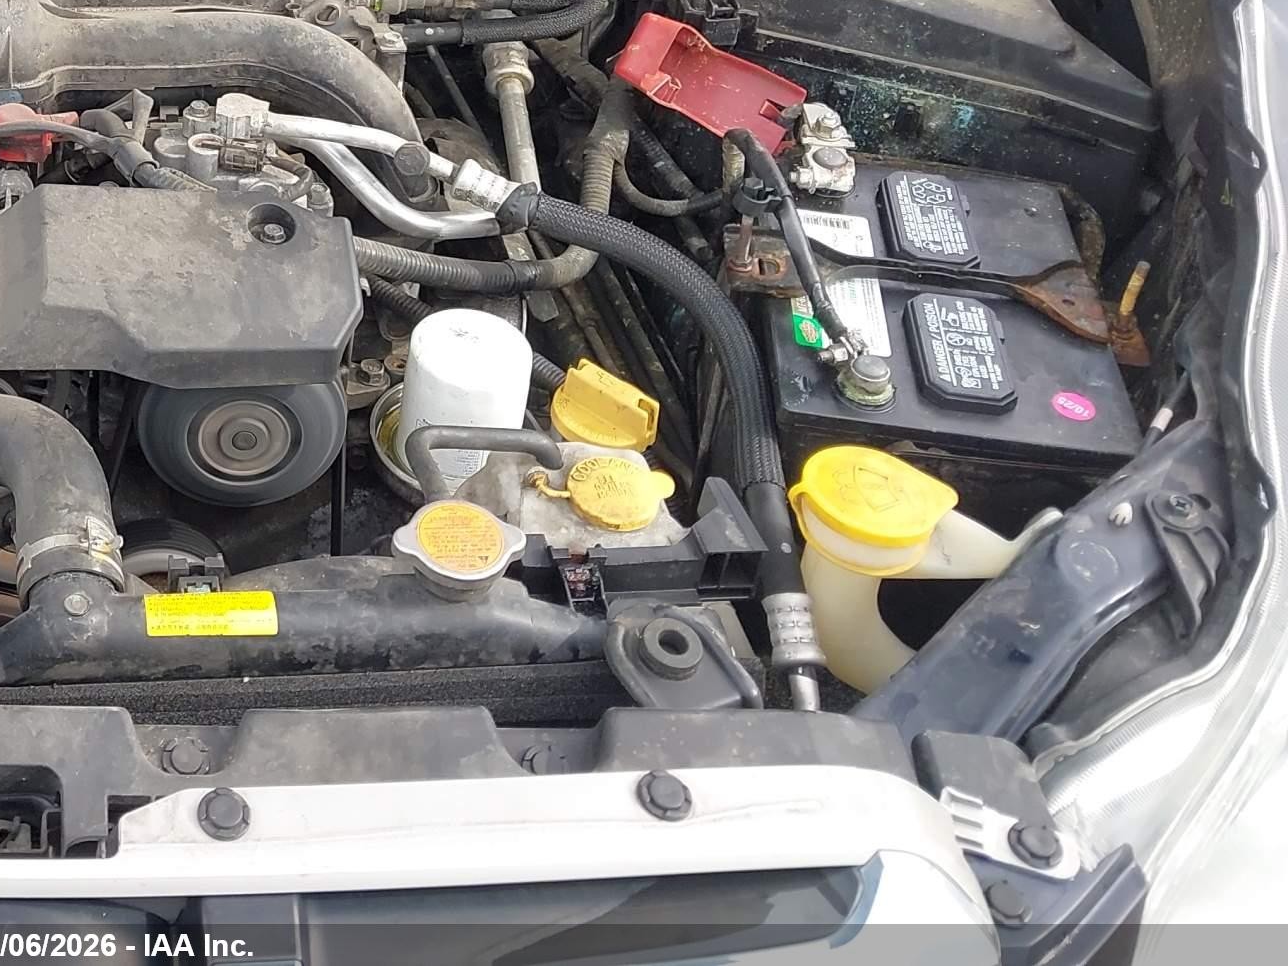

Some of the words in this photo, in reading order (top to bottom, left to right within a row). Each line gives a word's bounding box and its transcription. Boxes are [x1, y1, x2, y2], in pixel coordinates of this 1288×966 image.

[923, 302, 940, 333] POISON
[932, 339, 950, 374] DANGER
[1056, 396, 1090, 417] 10/25
